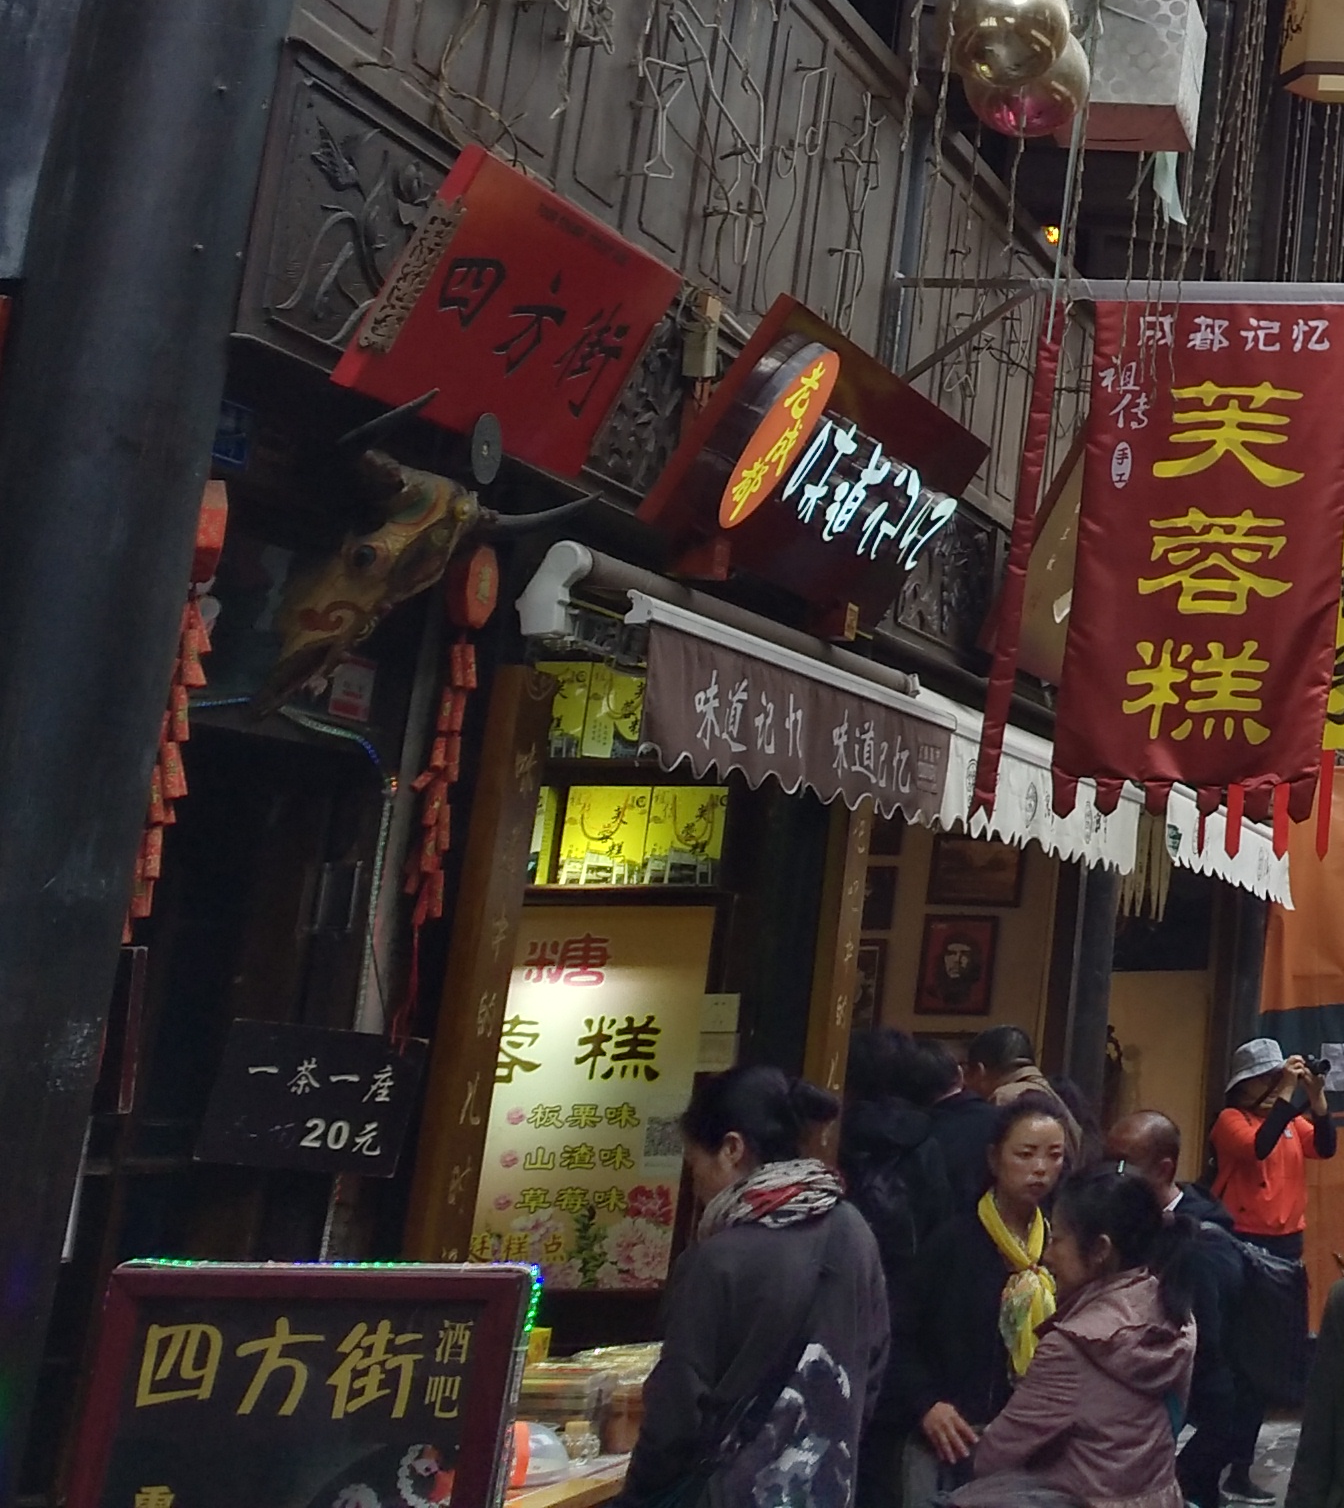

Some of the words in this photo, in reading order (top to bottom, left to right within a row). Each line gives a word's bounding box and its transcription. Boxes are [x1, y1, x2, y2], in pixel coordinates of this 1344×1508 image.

[438, 256, 631, 421] 四方街
[1137, 315, 1331, 352] 成都记忆
[1099, 354, 1151, 432] 祖传
[730, 361, 826, 522] 老成都
[1112, 445, 1131, 485] 手工
[1122, 380, 1306, 744] 芙蓉糕
[832, 708, 911, 794] 味道记忆
[524, 932, 612, 988] 糖
[247, 1056, 396, 1104] 一茶一座
[299, 1116, 383, 1158] 20元
[526, 1102, 640, 1130] 板栗味
[515, 1187, 629, 1215] 草莓味
[135, 1316, 424, 1420] 四方街
[424, 1318, 475, 1419] 酒吧
